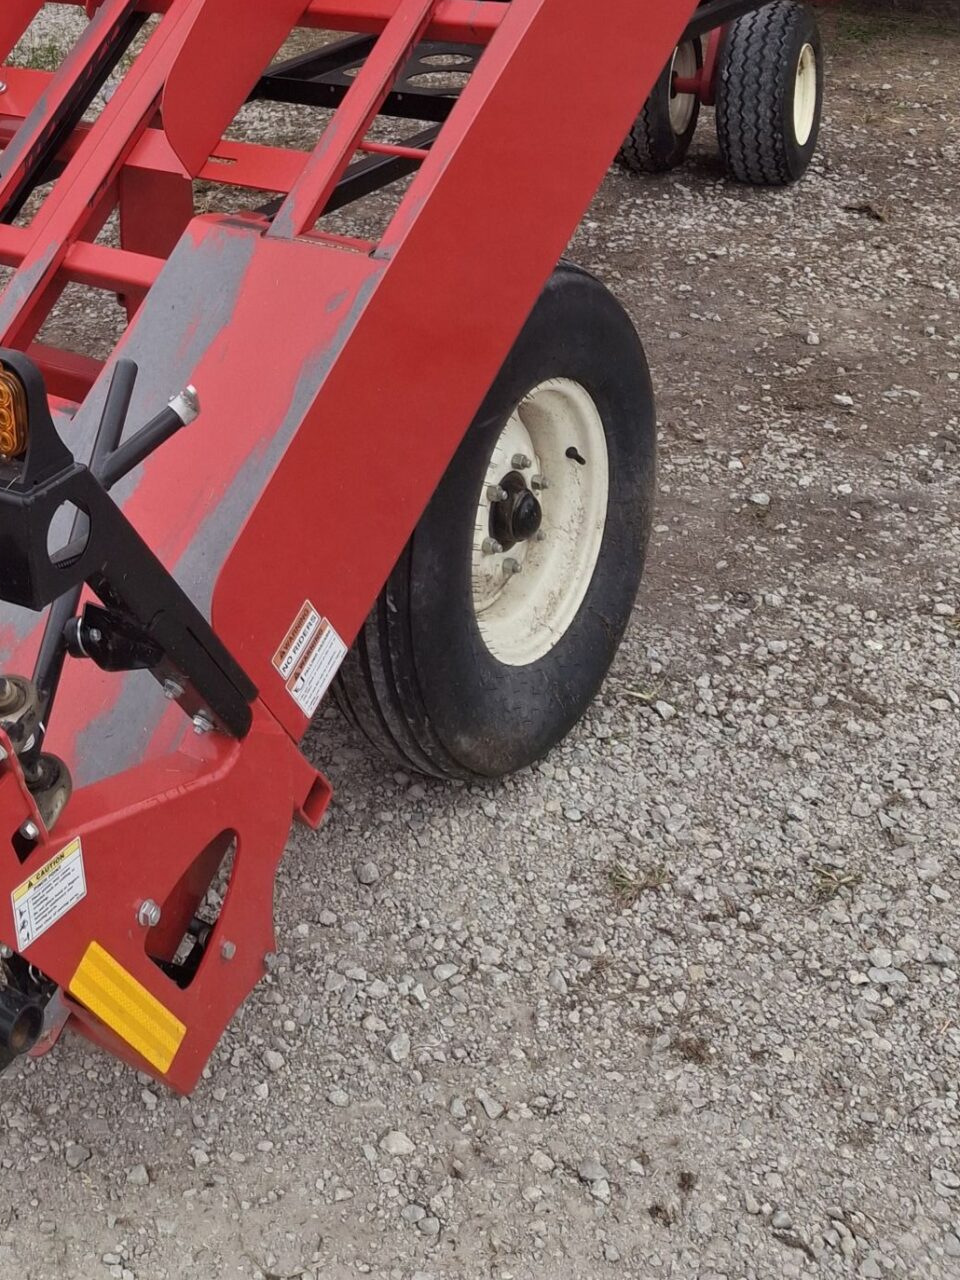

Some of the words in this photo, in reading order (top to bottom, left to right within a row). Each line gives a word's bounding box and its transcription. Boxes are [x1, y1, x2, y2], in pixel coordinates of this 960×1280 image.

[282, 655, 293, 673] NO
[292, 615, 317, 655] RIDERS
[283, 607, 310, 651] WARNING
[299, 627, 324, 669] WARNING
[35, 851, 65, 880] CAUTION
